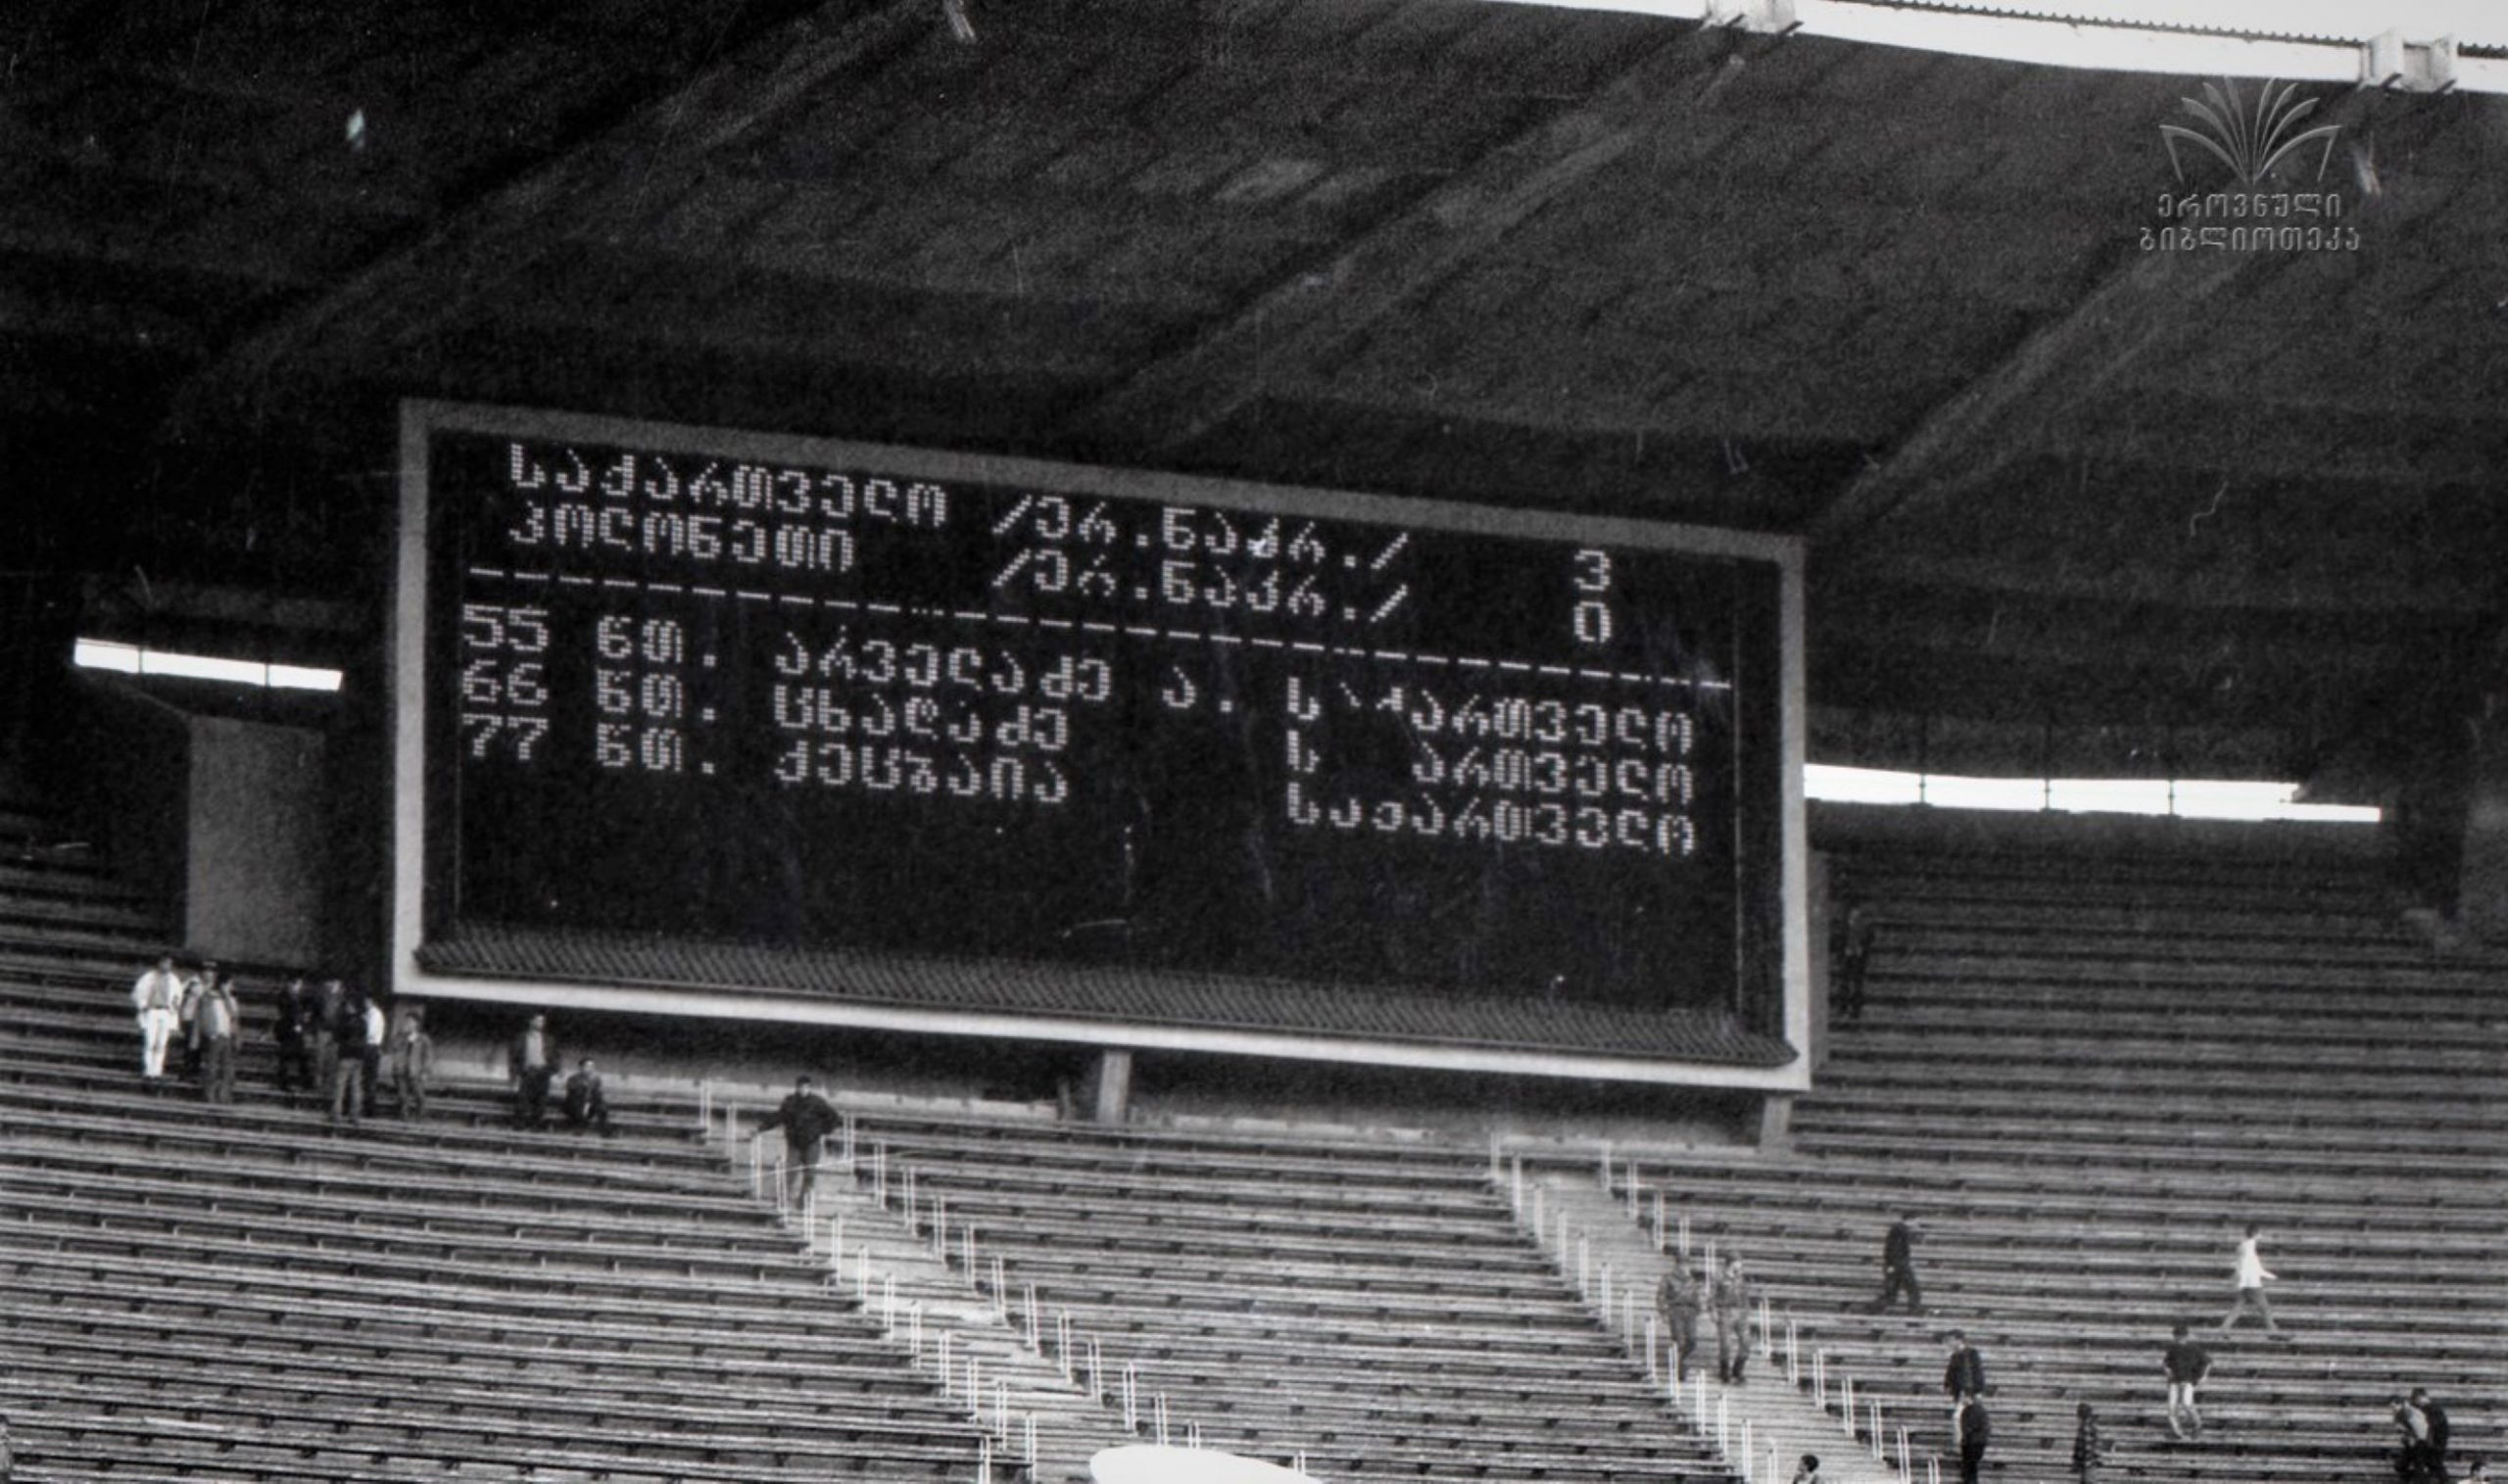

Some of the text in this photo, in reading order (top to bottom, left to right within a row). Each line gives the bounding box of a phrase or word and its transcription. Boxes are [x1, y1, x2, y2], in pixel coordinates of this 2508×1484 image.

[508, 501, 854, 572] პოლონეთი
[1573, 599, 1612, 646] 0
[510, 443, 948, 527] საქართველო
[1574, 549, 1612, 595] 3
[461, 603, 550, 652] 55
[774, 624, 1112, 702] არველაძე
[461, 658, 550, 706] 66
[1287, 729, 1693, 807] სართველო
[461, 713, 550, 761] 77
